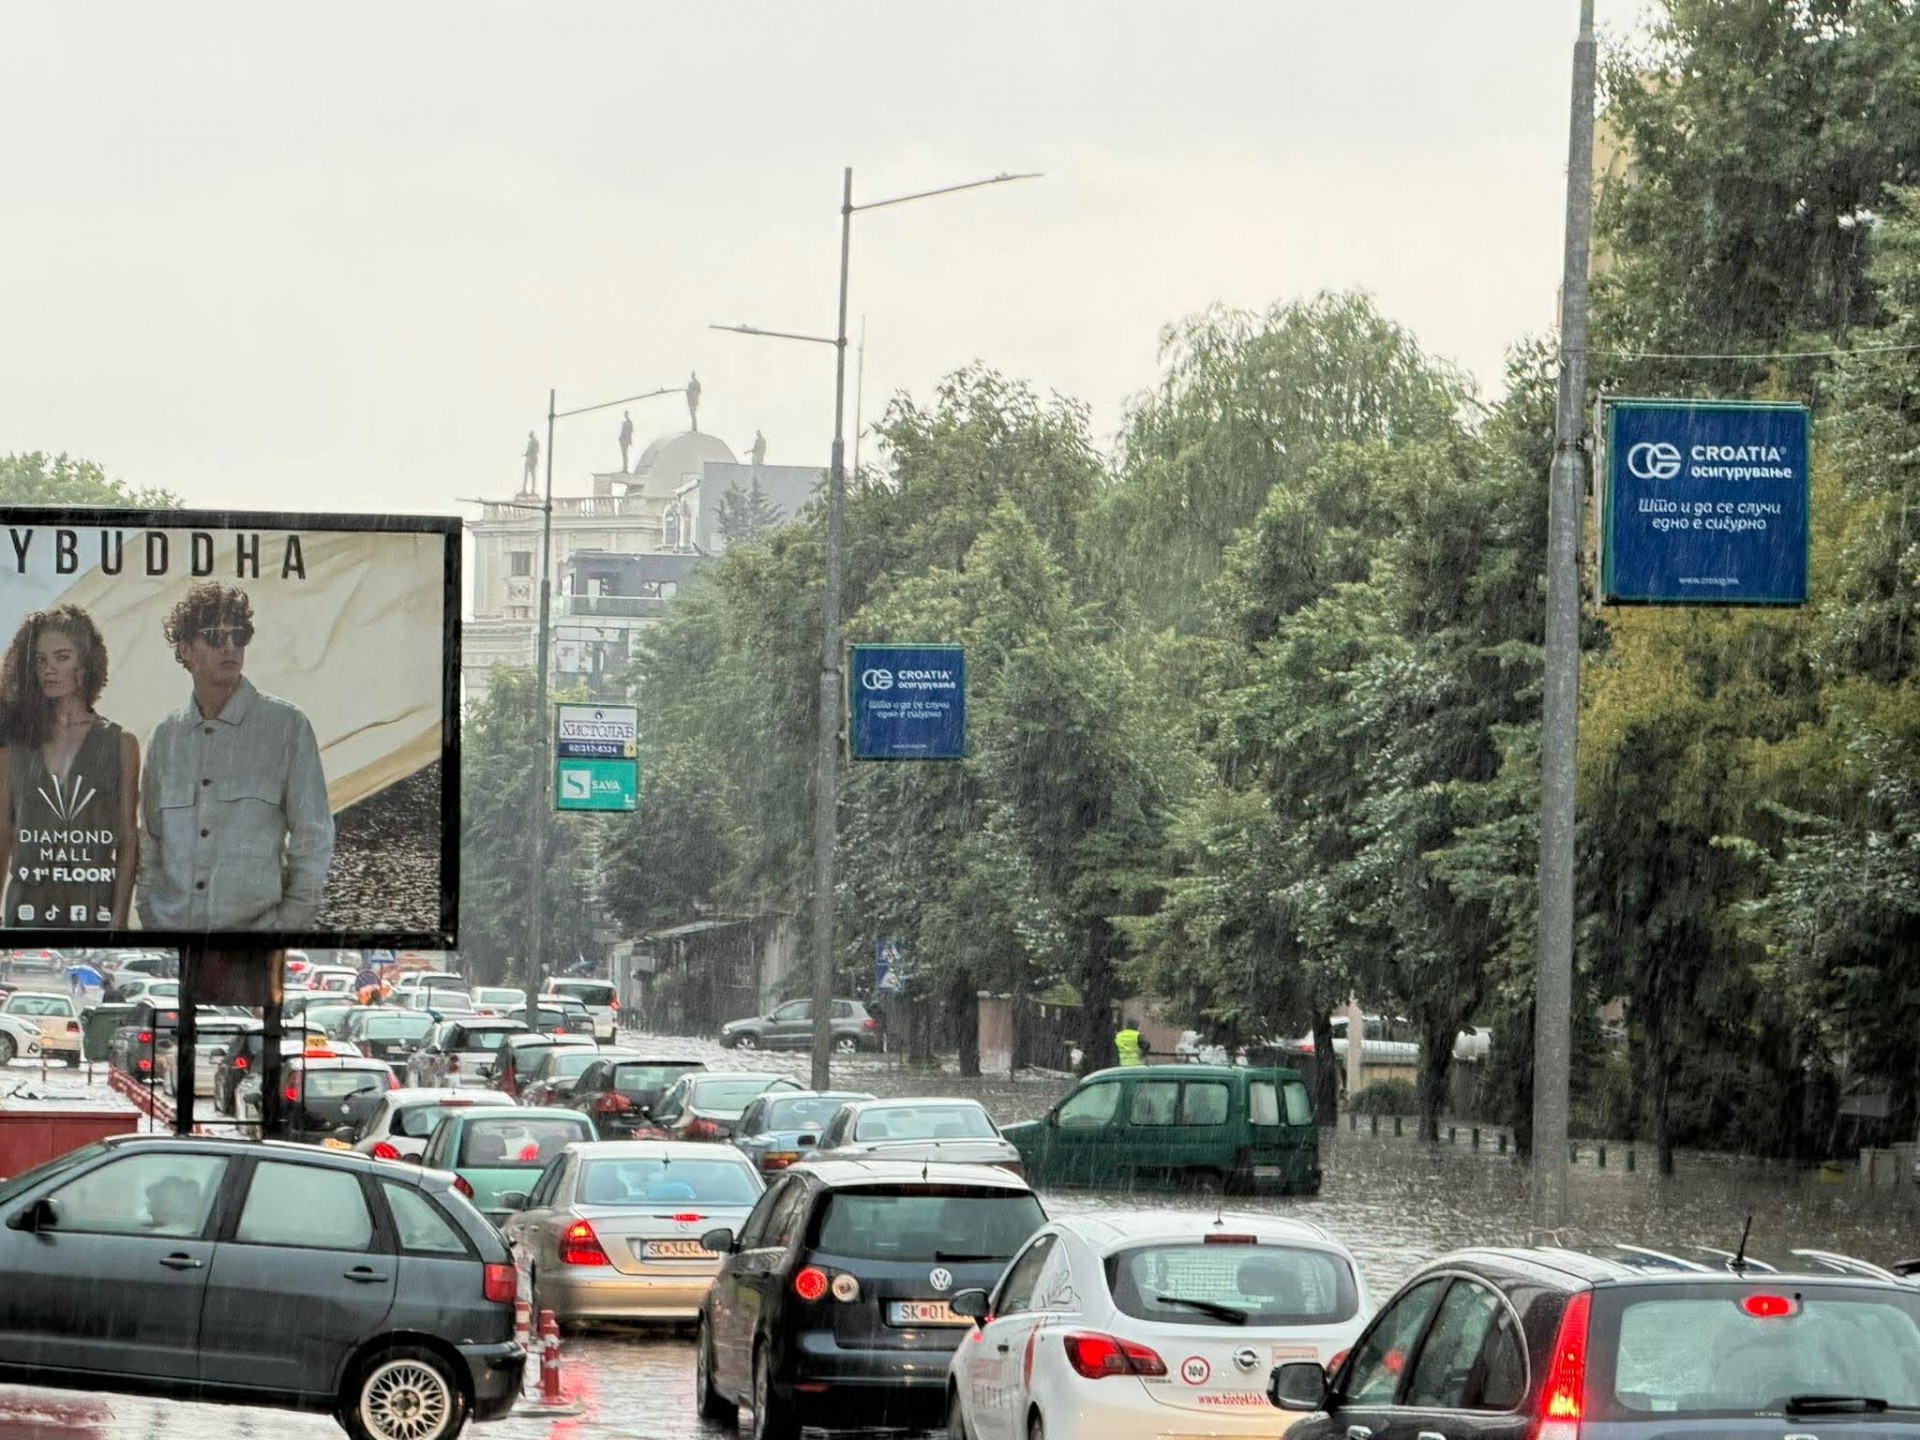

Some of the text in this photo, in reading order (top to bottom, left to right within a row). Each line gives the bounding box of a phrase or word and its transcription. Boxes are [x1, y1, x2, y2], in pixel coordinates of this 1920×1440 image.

[1691, 446, 1781, 461] CROATIA
[1691, 466, 1792, 480] осигурување
[898, 670, 949, 680] CROATIA
[591, 781, 620, 790] SAVA
[20, 829, 114, 844] DIAMOND
[40, 848, 92, 861] MALL
[53, 867, 112, 882] FLOOR
[902, 1304, 919, 1319] SK
